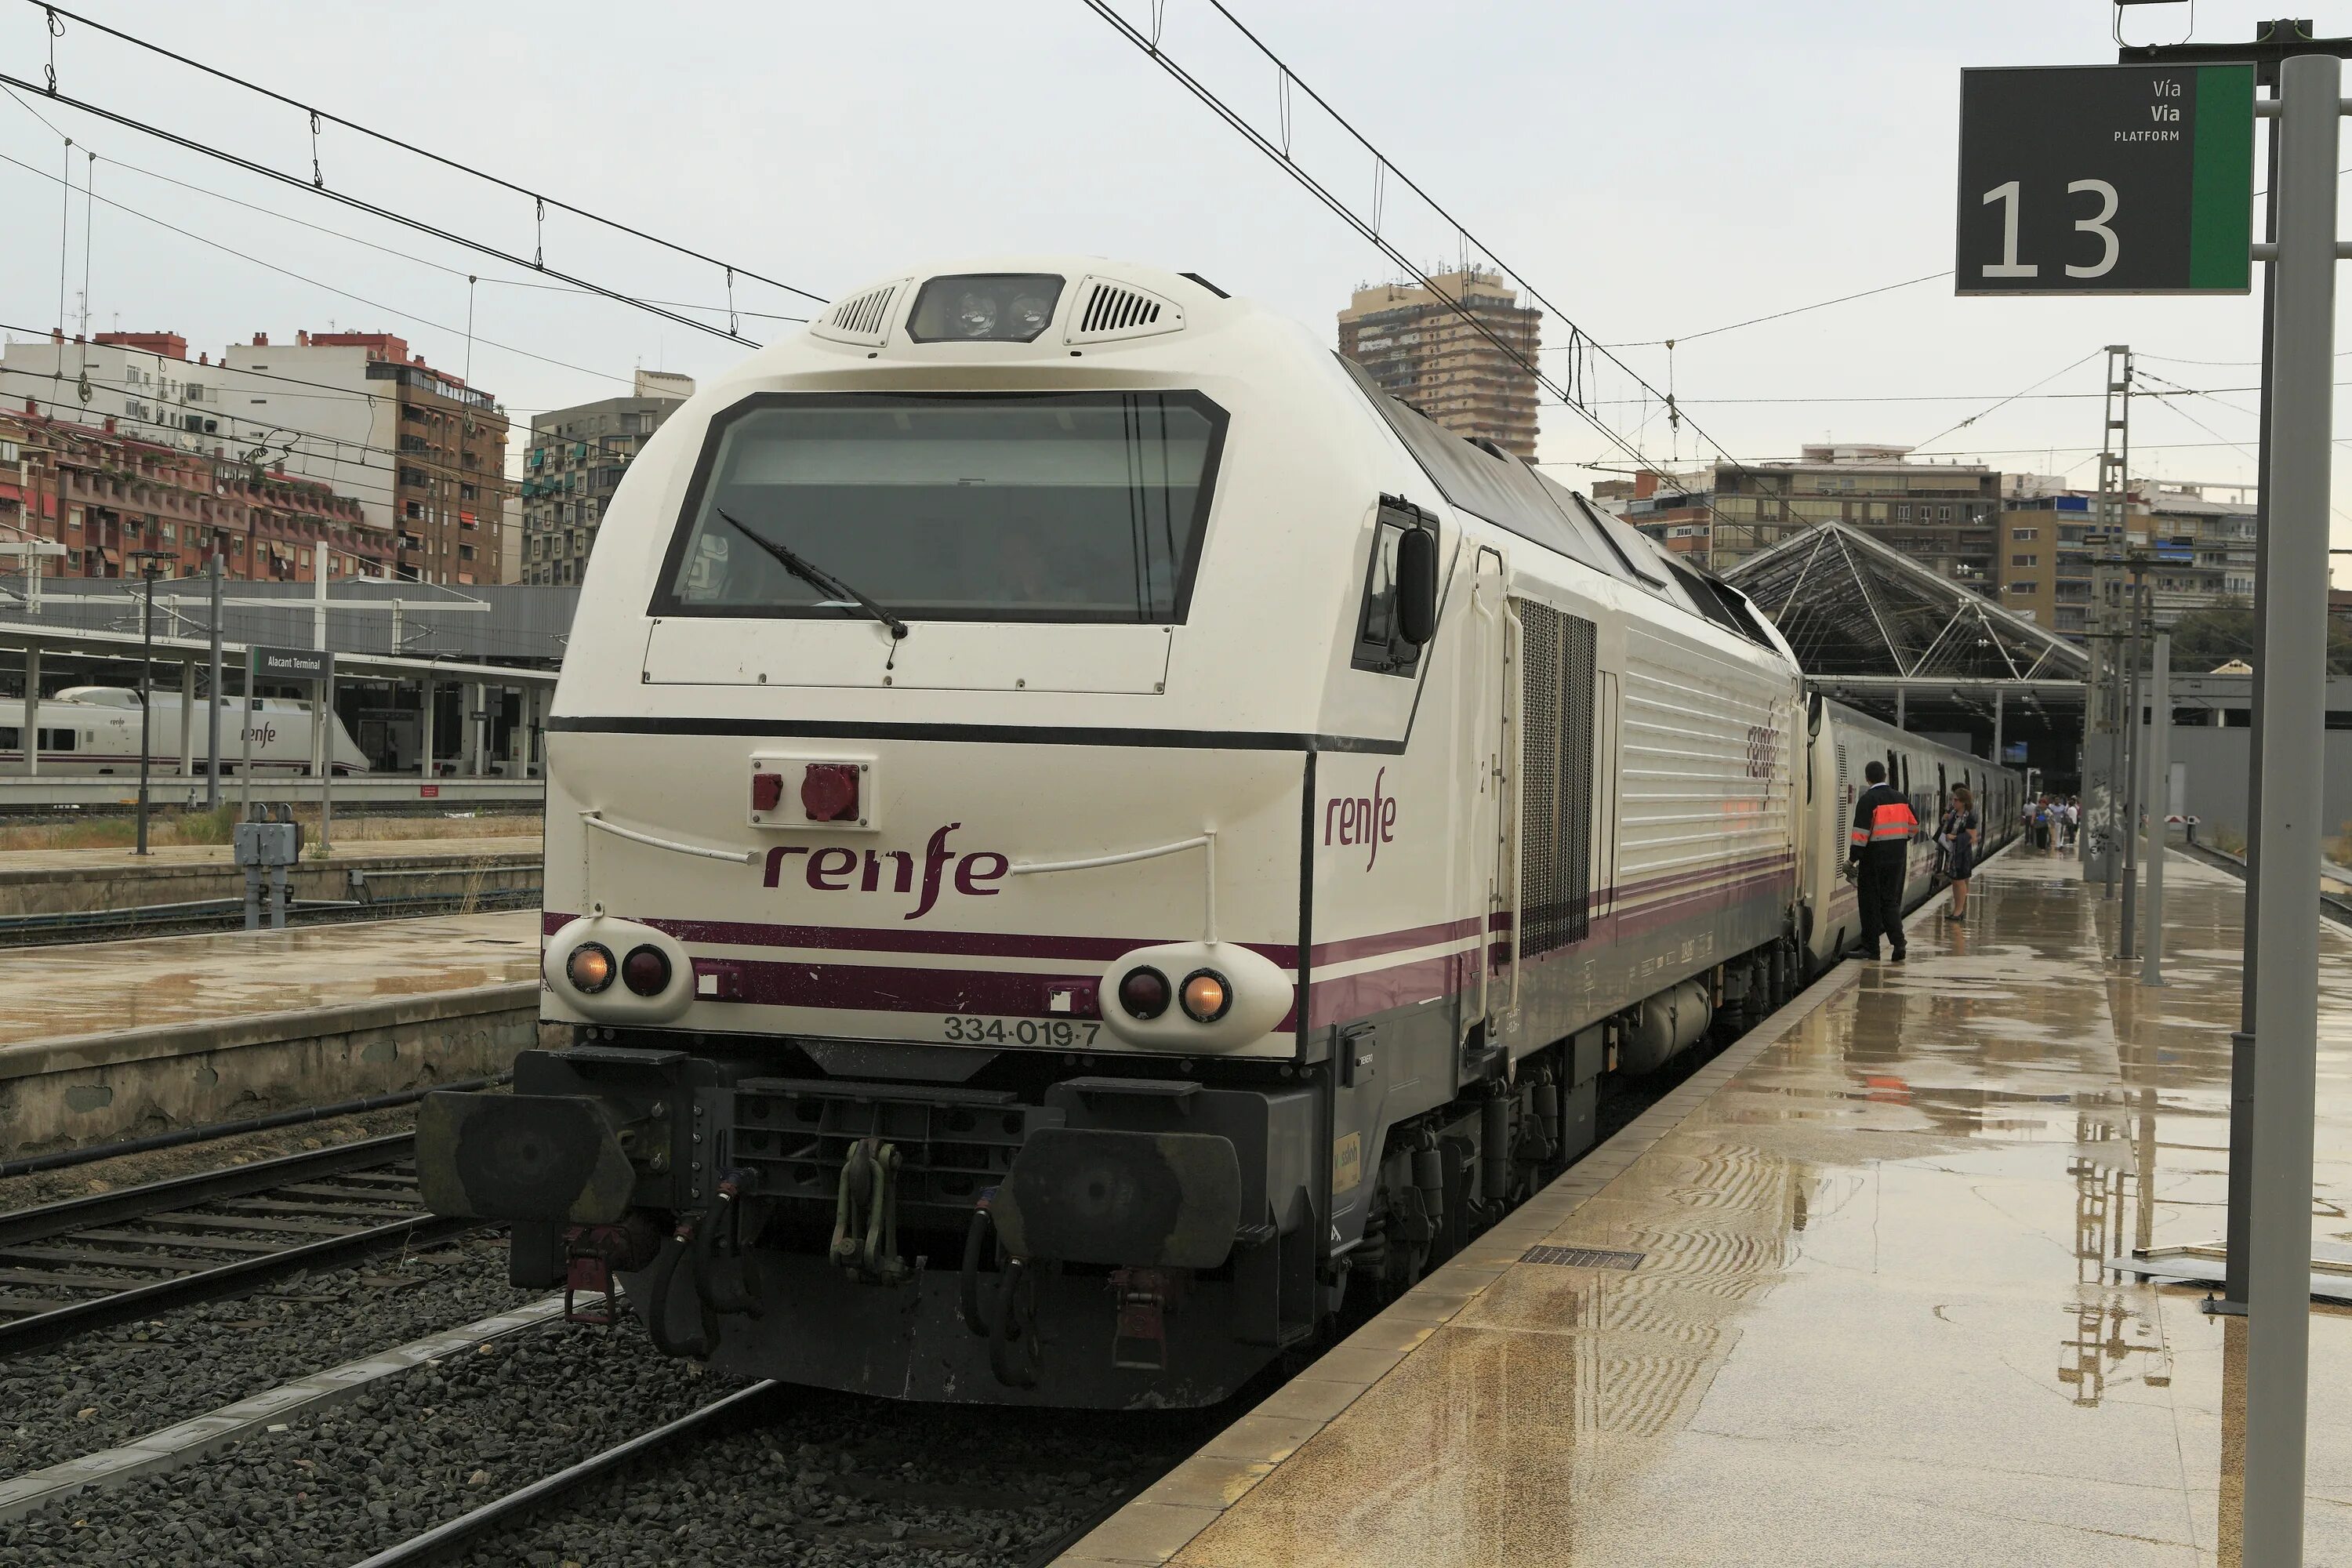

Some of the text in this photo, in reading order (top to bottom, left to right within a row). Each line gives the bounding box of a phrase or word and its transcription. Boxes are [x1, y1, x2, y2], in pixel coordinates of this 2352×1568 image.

[2153, 79, 2181, 97] Vía
[2151, 104, 2180, 122] Via
[2114, 130, 2180, 141] PLATFORM
[267, 655, 321, 670] Alacant Terminal
[110, 717, 125, 728] renfe
[1324, 766, 1396, 873] renfe
[763, 822, 1009, 920] renfe
